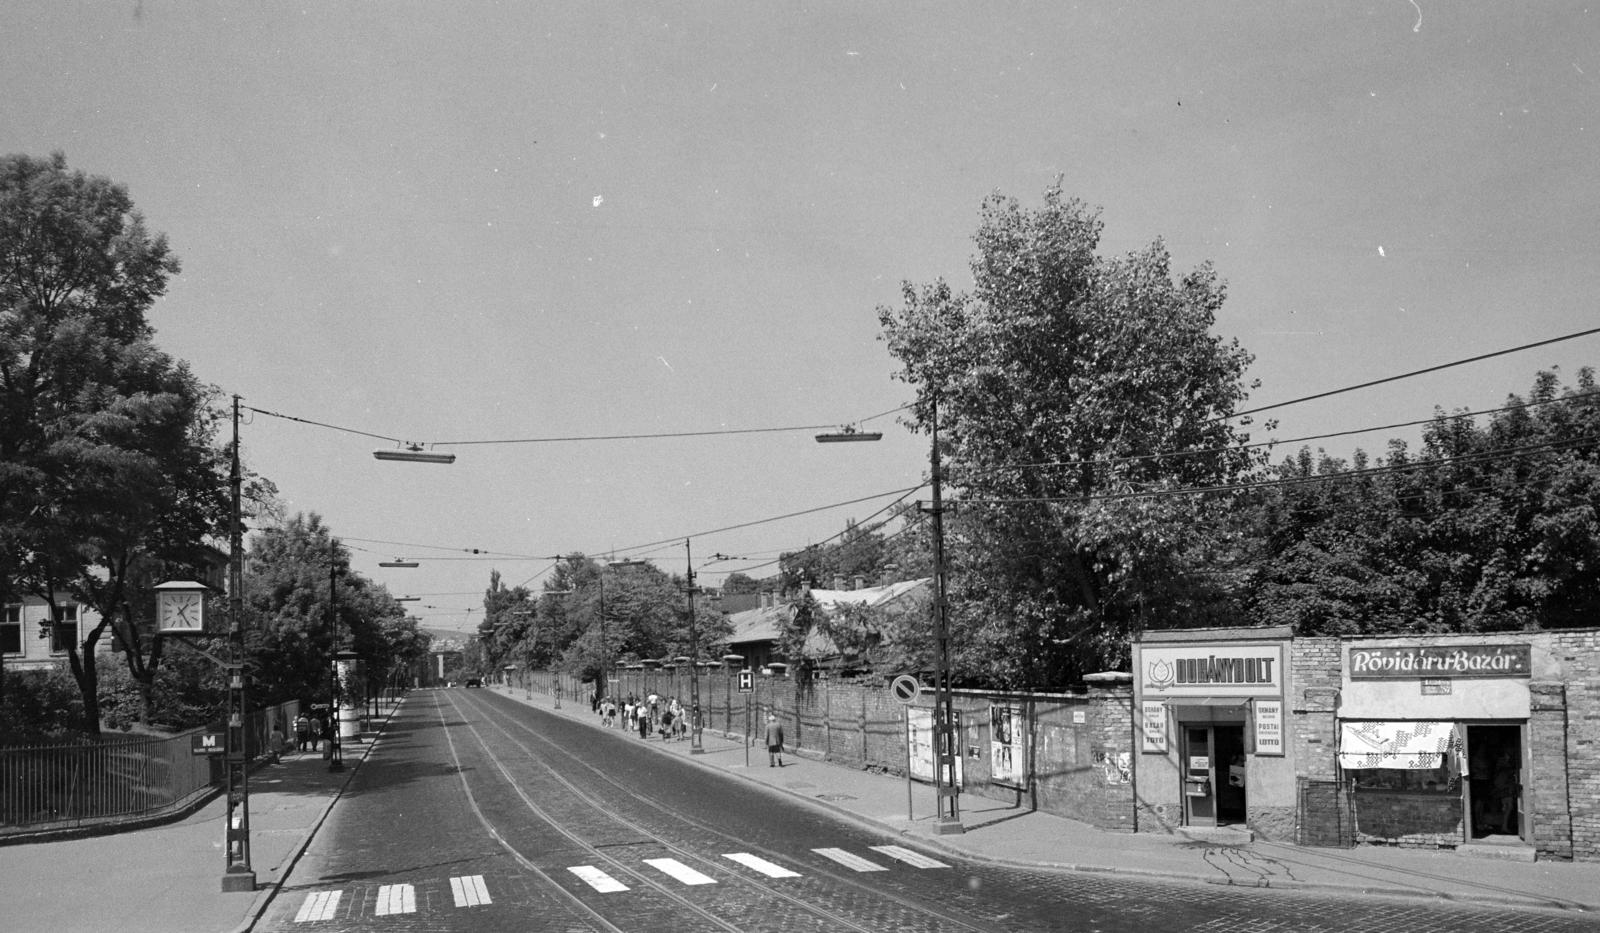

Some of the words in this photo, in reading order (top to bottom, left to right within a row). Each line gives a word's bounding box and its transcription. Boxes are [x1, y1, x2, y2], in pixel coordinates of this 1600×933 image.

[1176, 655, 1275, 683] DOHÁNYBOLT
[740, 674, 751, 688] H
[202, 735, 216, 747] M
